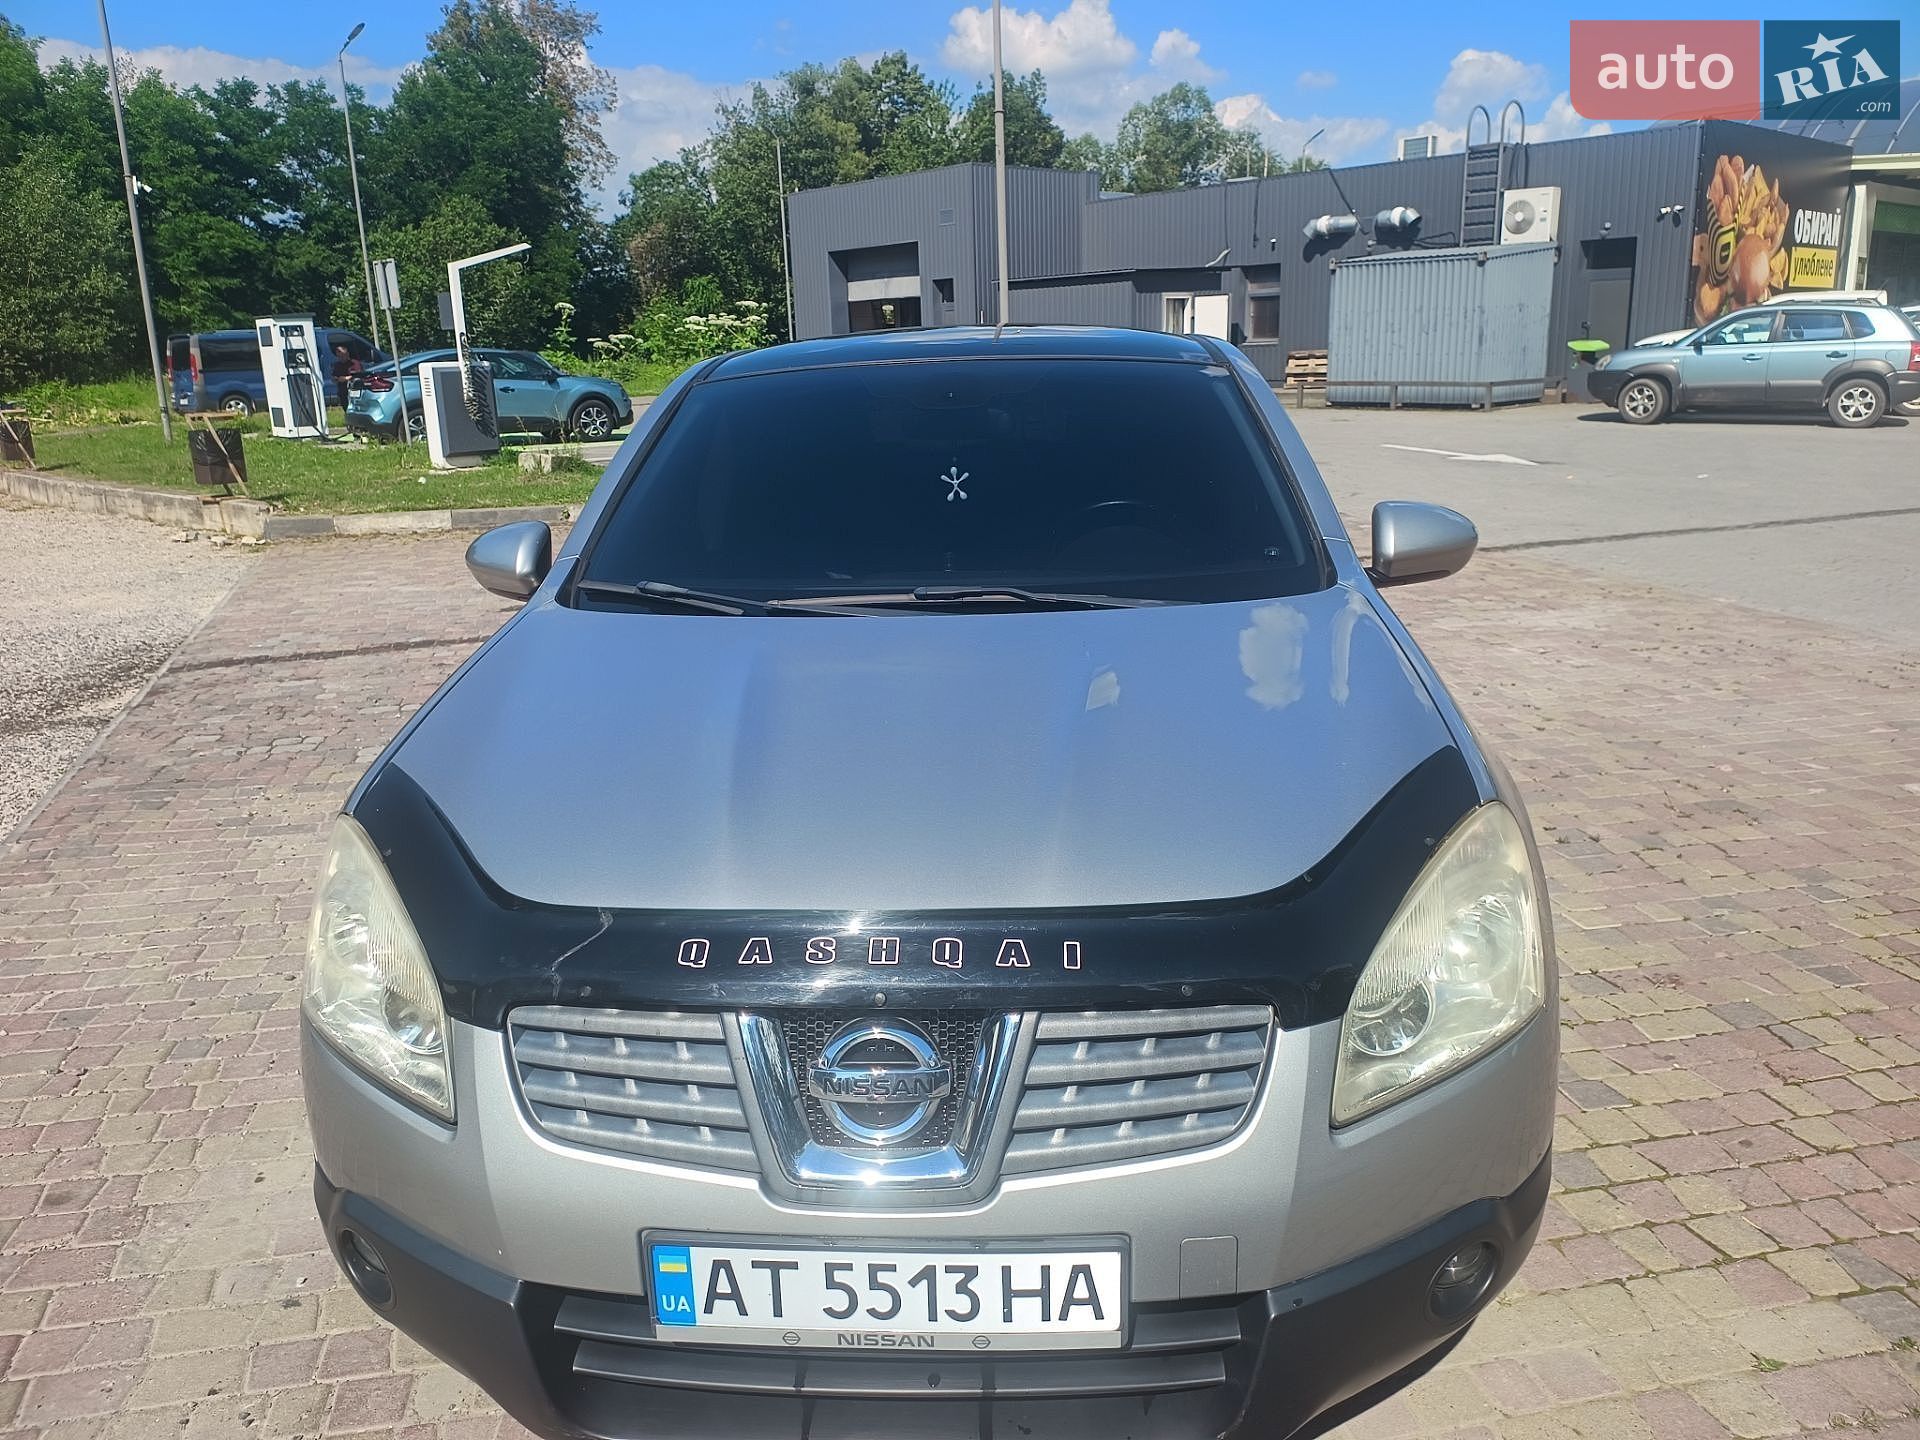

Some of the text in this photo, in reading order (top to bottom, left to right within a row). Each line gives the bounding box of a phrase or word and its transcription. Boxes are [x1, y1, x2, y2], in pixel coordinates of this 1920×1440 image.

[1794, 208, 1841, 246] ОБИРАЙ
[1792, 252, 1834, 282] улюблене
[677, 937, 1083, 970] QASHQAI
[823, 1075, 936, 1097] NISSAN
[662, 1293, 691, 1313] UA
[703, 1259, 1104, 1322] AT 5513 HA
[837, 1332, 935, 1348] NISSAN
